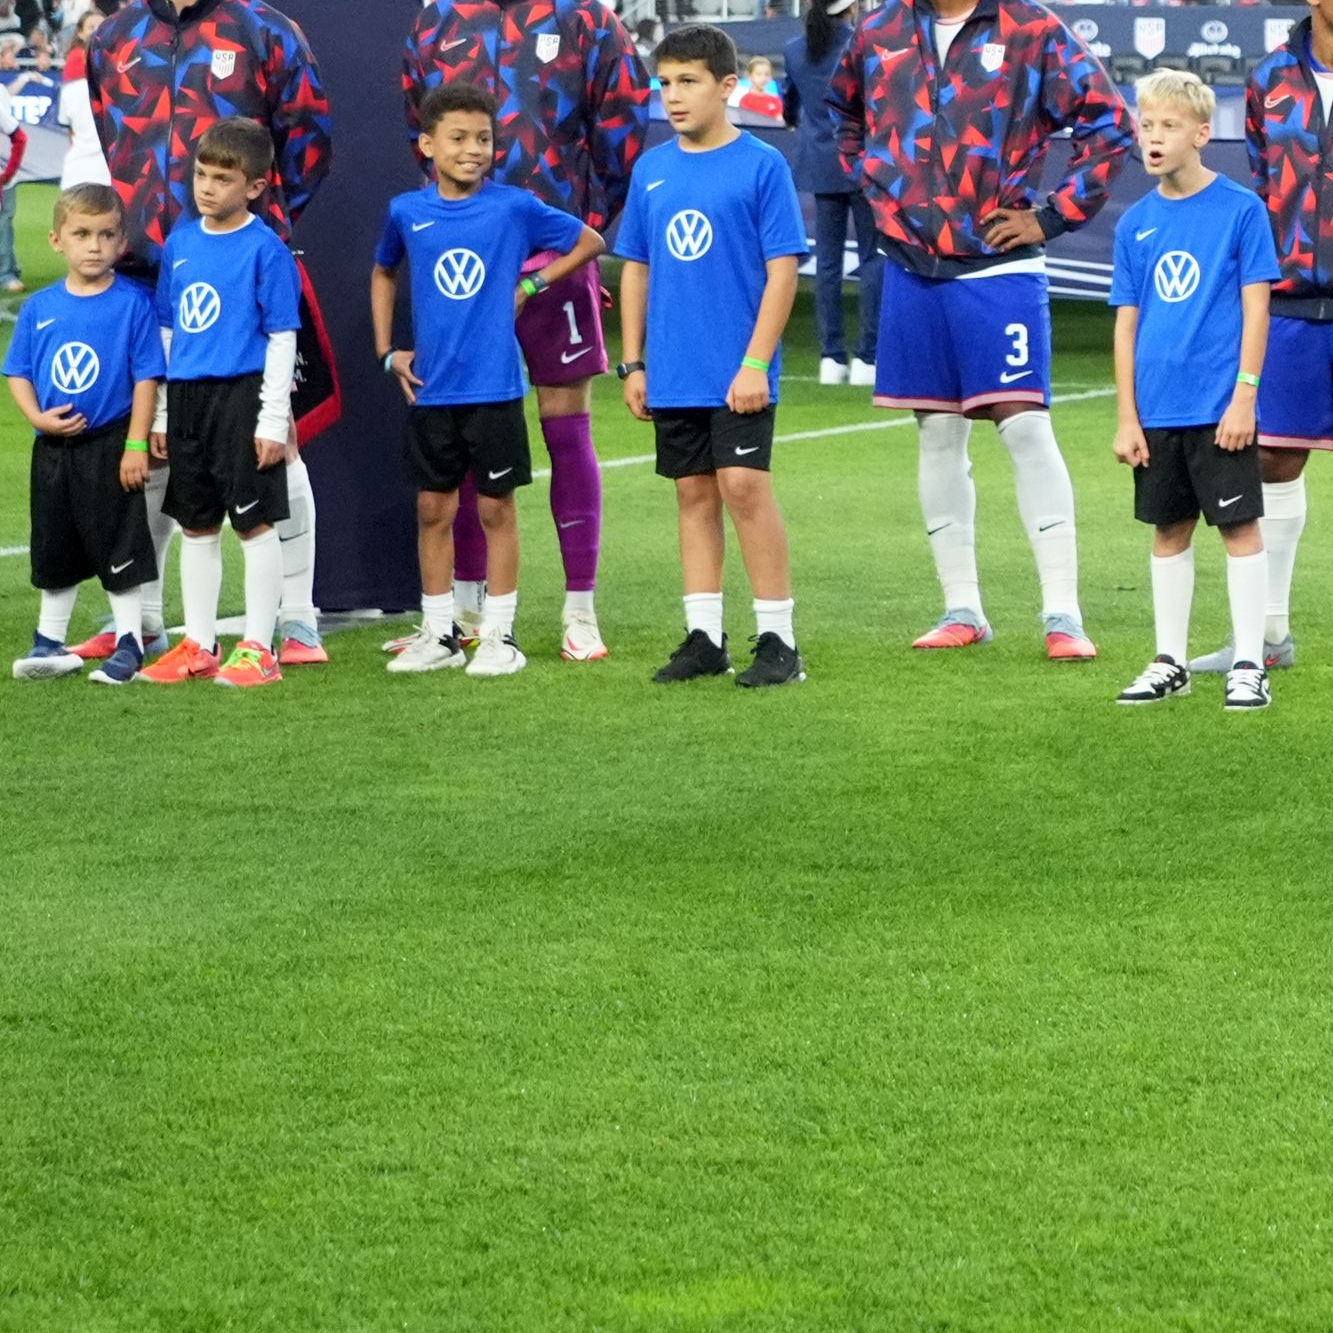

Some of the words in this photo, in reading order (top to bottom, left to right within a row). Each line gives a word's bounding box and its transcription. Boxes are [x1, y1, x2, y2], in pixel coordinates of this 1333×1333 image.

[666, 210, 713, 260] VW
[434, 248, 485, 299] VW
[1154, 250, 1200, 302] VW
[180, 282, 221, 333] VW
[563, 301, 582, 345] 1
[51, 341, 100, 393] VW
[1005, 323, 1029, 366] 3
